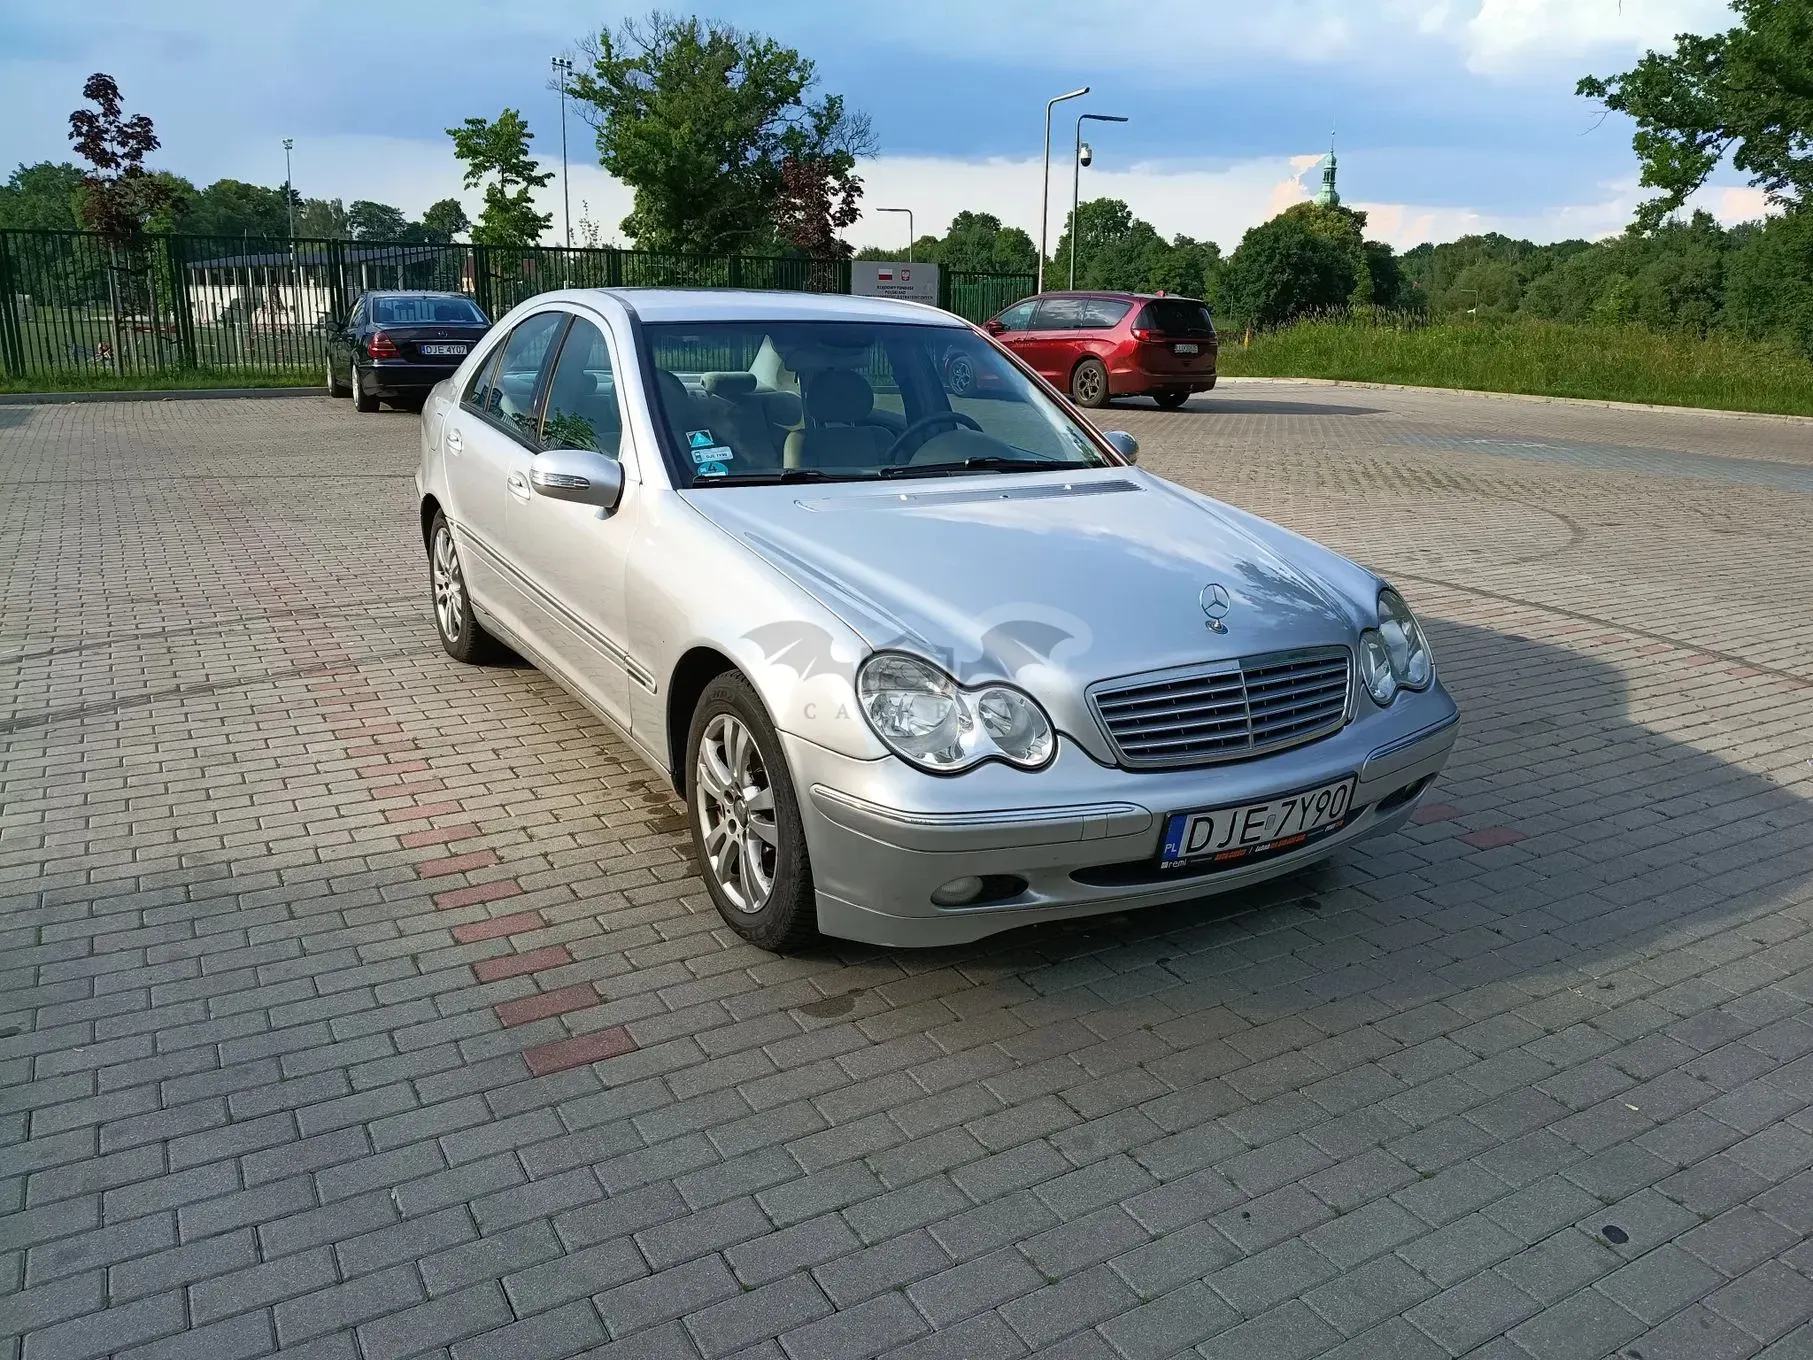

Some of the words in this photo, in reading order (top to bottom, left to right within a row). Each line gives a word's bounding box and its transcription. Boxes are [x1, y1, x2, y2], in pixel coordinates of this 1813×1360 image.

[426, 345, 444, 354] DJE
[446, 345, 466, 354] 4Y07
[1186, 806, 1270, 854] DJE
[1273, 784, 1349, 838] 7Y90
[1164, 842, 1177, 854] PL
